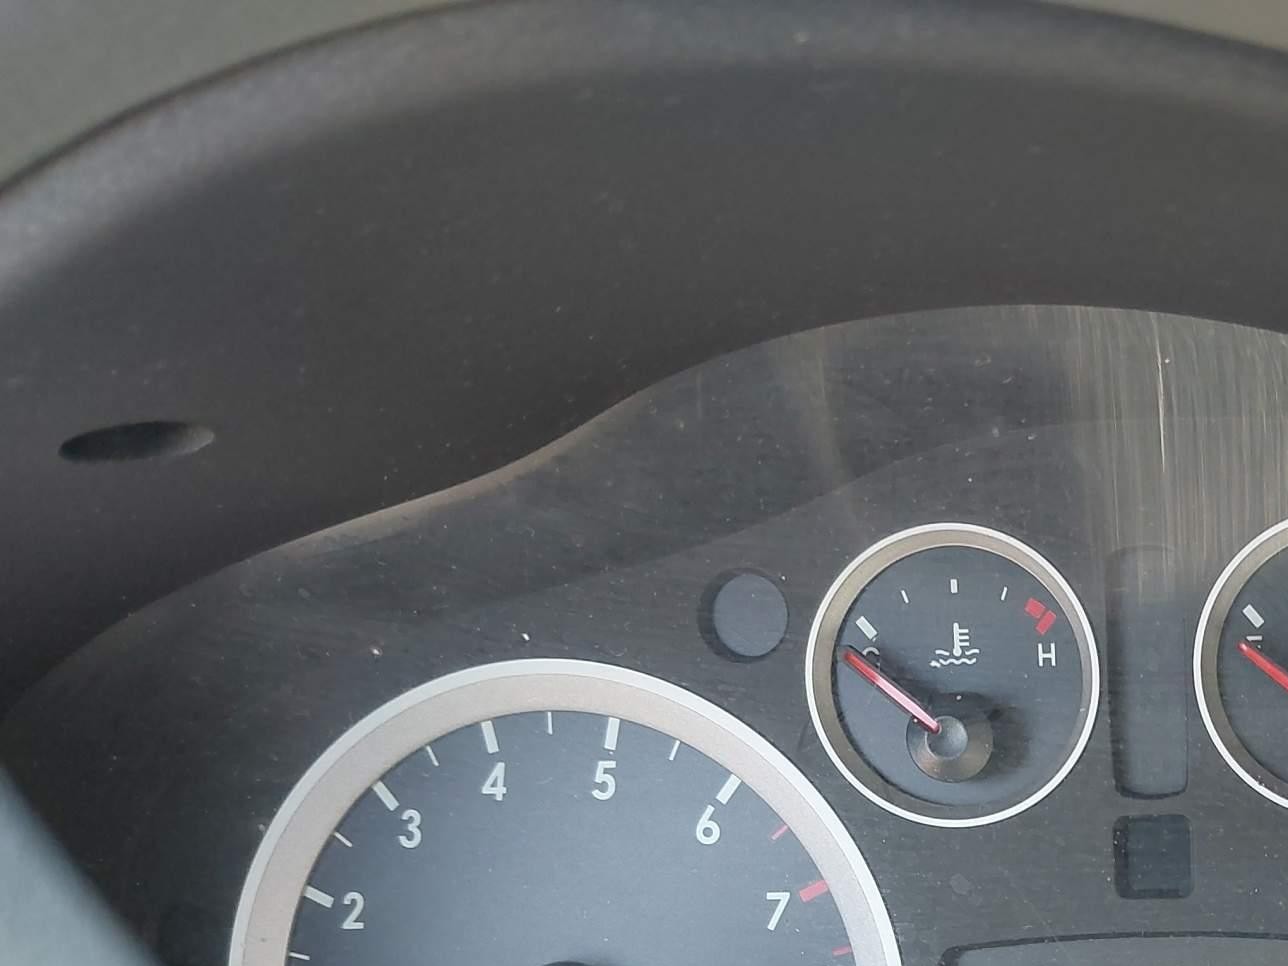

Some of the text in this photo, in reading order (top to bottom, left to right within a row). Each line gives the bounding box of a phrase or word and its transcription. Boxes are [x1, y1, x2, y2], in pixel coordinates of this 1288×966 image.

[1037, 642, 1056, 667] H
[481, 761, 507, 801] 4
[591, 760, 617, 801] 5
[398, 809, 422, 849] 3
[695, 804, 721, 845] 6
[341, 891, 365, 930] 2
[766, 891, 791, 931] 7
